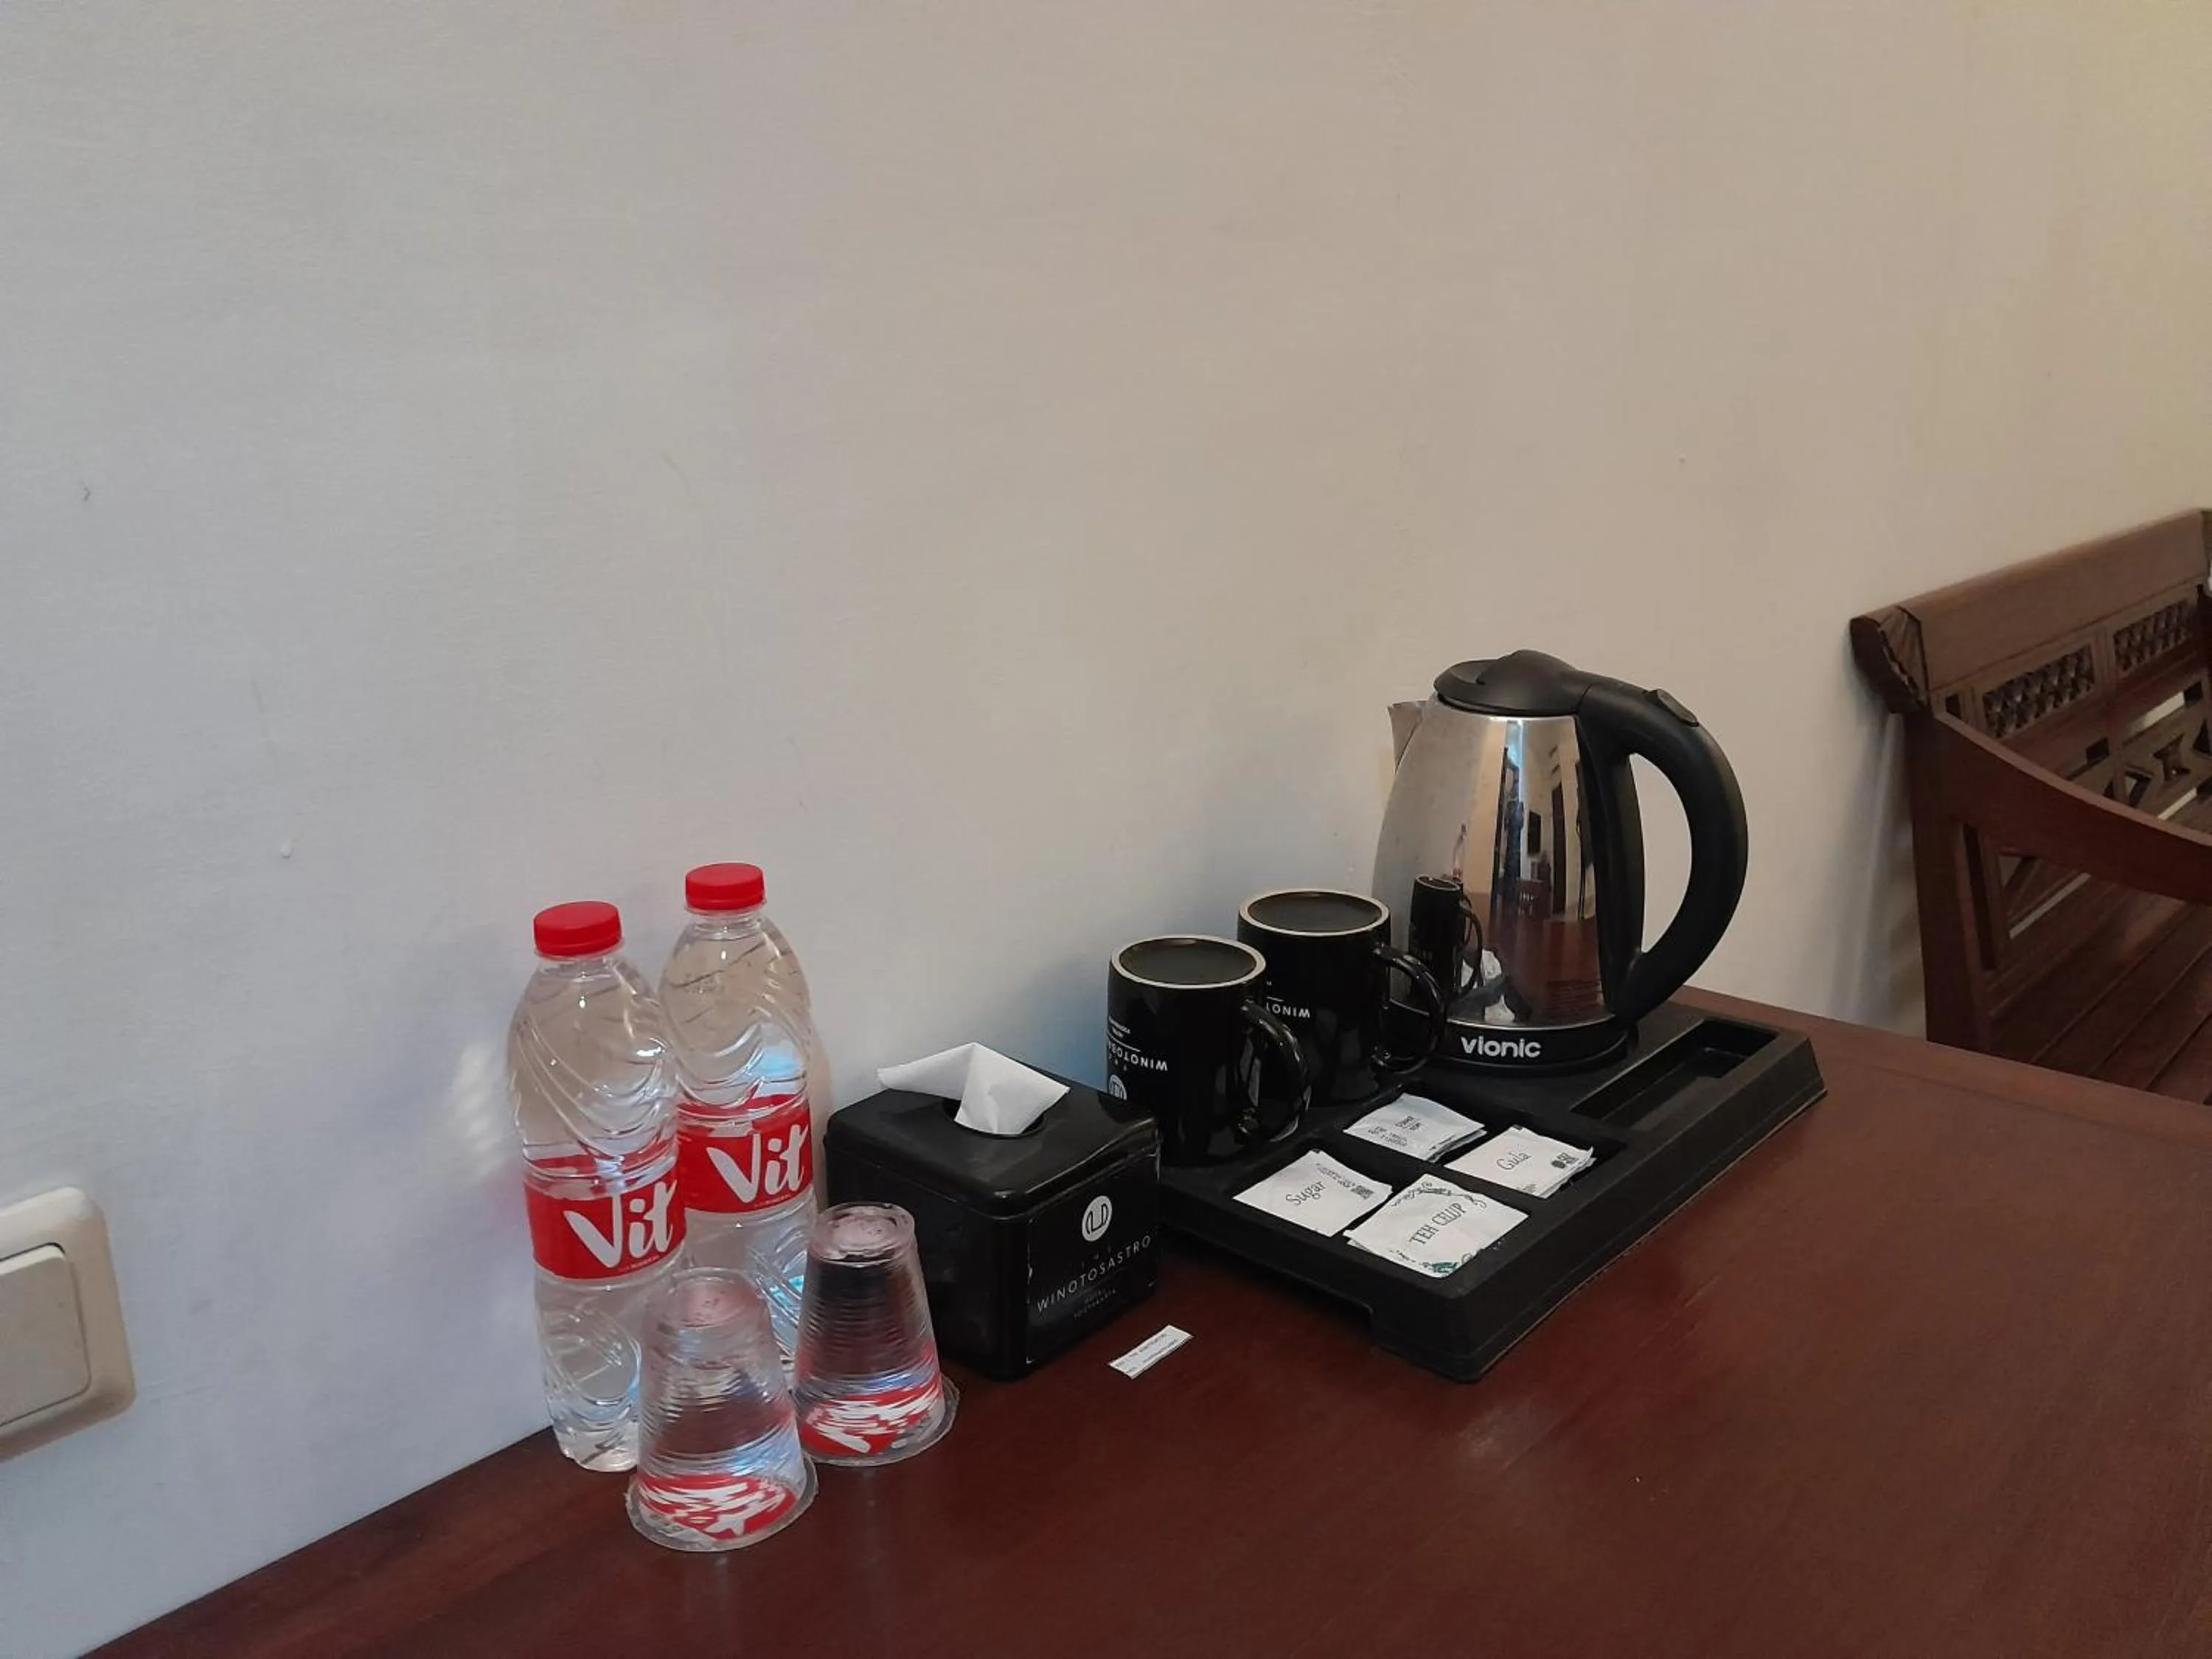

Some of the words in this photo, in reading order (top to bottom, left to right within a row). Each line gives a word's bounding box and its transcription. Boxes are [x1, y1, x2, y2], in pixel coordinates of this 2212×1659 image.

[1460, 1035, 1541, 1059] vionic
[706, 1122, 809, 1204] Vit
[1496, 1150, 1531, 1170] Gula
[1285, 1180, 1327, 1206] Sugar
[563, 1180, 678, 1269] Vit
[1409, 1225, 1440, 1245] TEH
[1431, 1202, 1467, 1227] CELUP
[1036, 1234, 1152, 1313] WINOTOSASTRO
